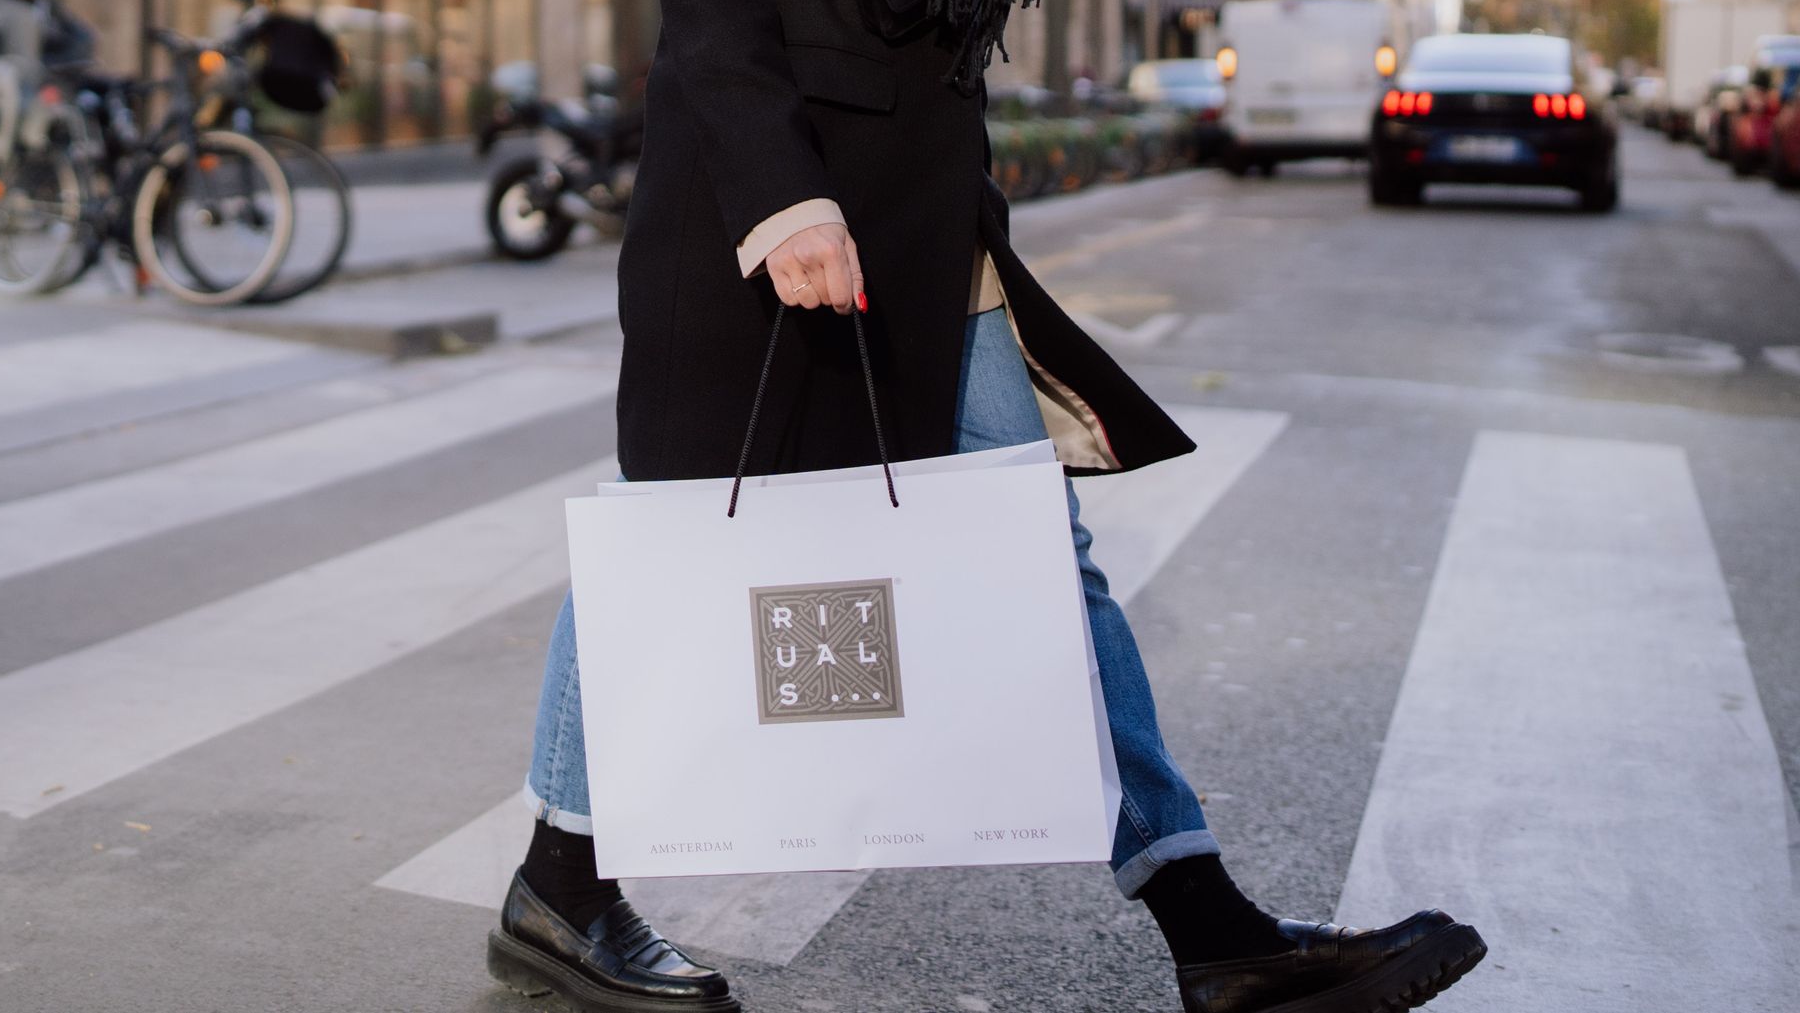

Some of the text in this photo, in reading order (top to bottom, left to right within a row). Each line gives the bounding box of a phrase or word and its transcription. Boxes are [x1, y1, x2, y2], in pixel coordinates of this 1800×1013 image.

[650, 827, 1050, 855] AMSTERDAM PARIS LONDON NEW YORK
